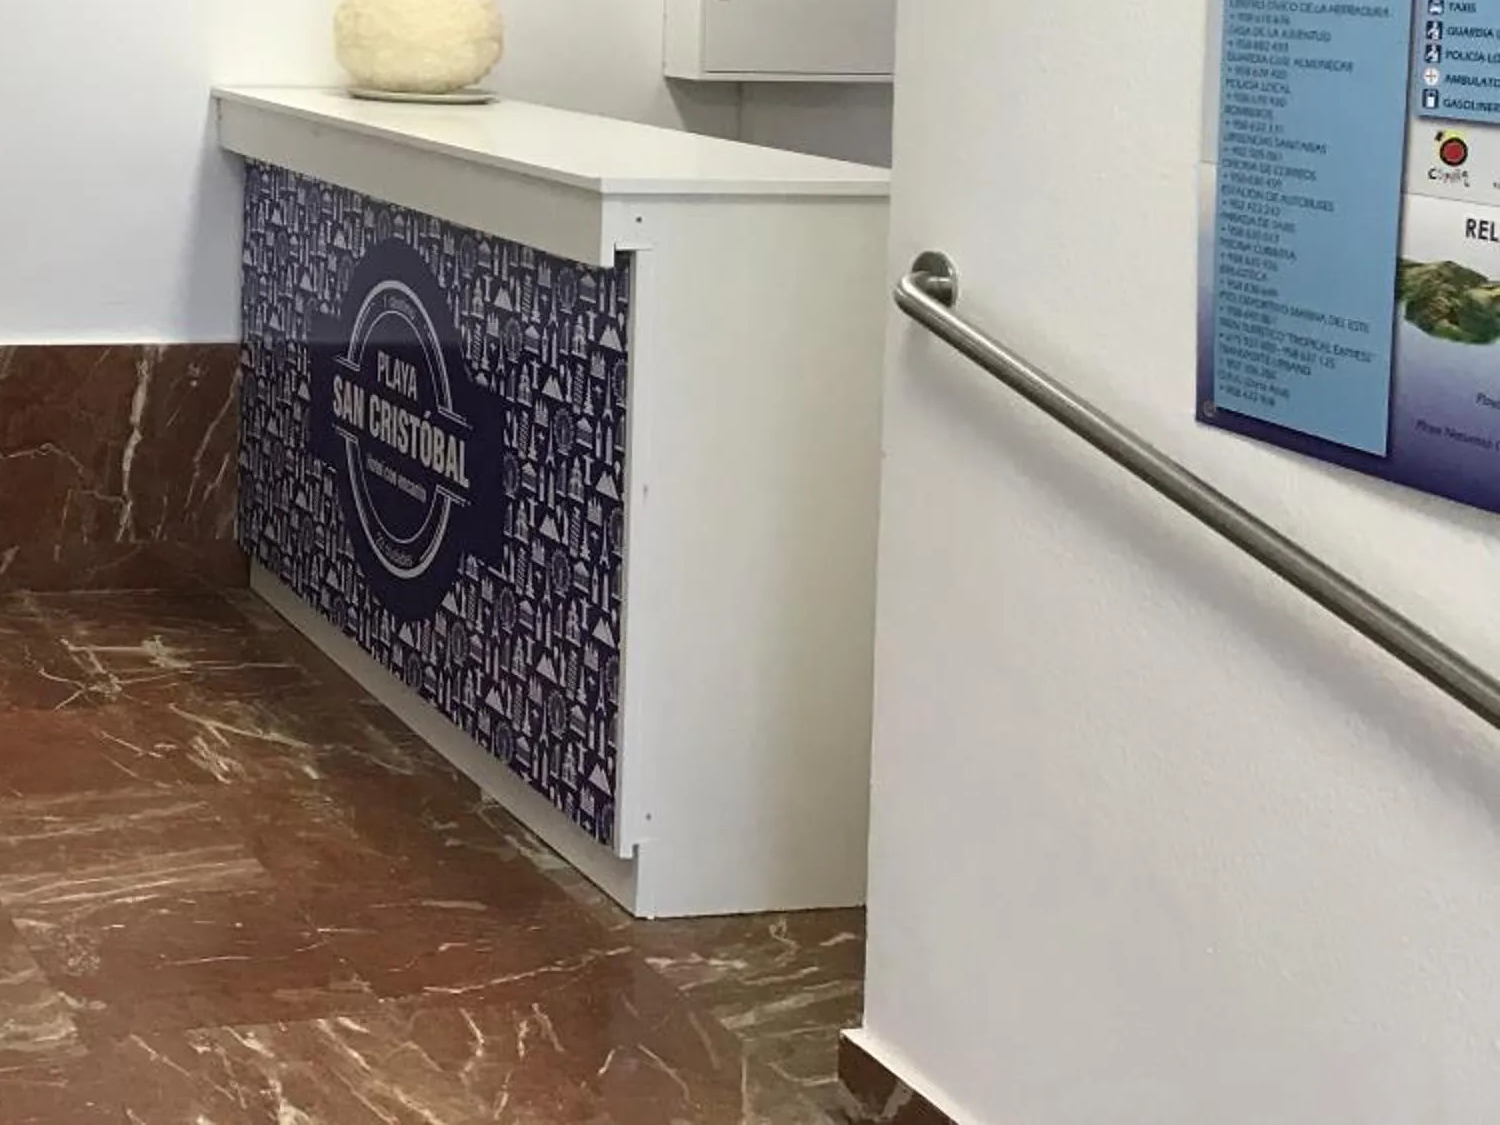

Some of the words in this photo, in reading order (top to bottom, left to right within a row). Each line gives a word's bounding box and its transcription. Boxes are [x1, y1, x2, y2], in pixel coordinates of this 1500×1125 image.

[1465, 218, 1499, 243] REL
[376, 350, 418, 401] PLAYA
[332, 375, 365, 430] SAN
[368, 393, 471, 489] CRISTÓBAL
